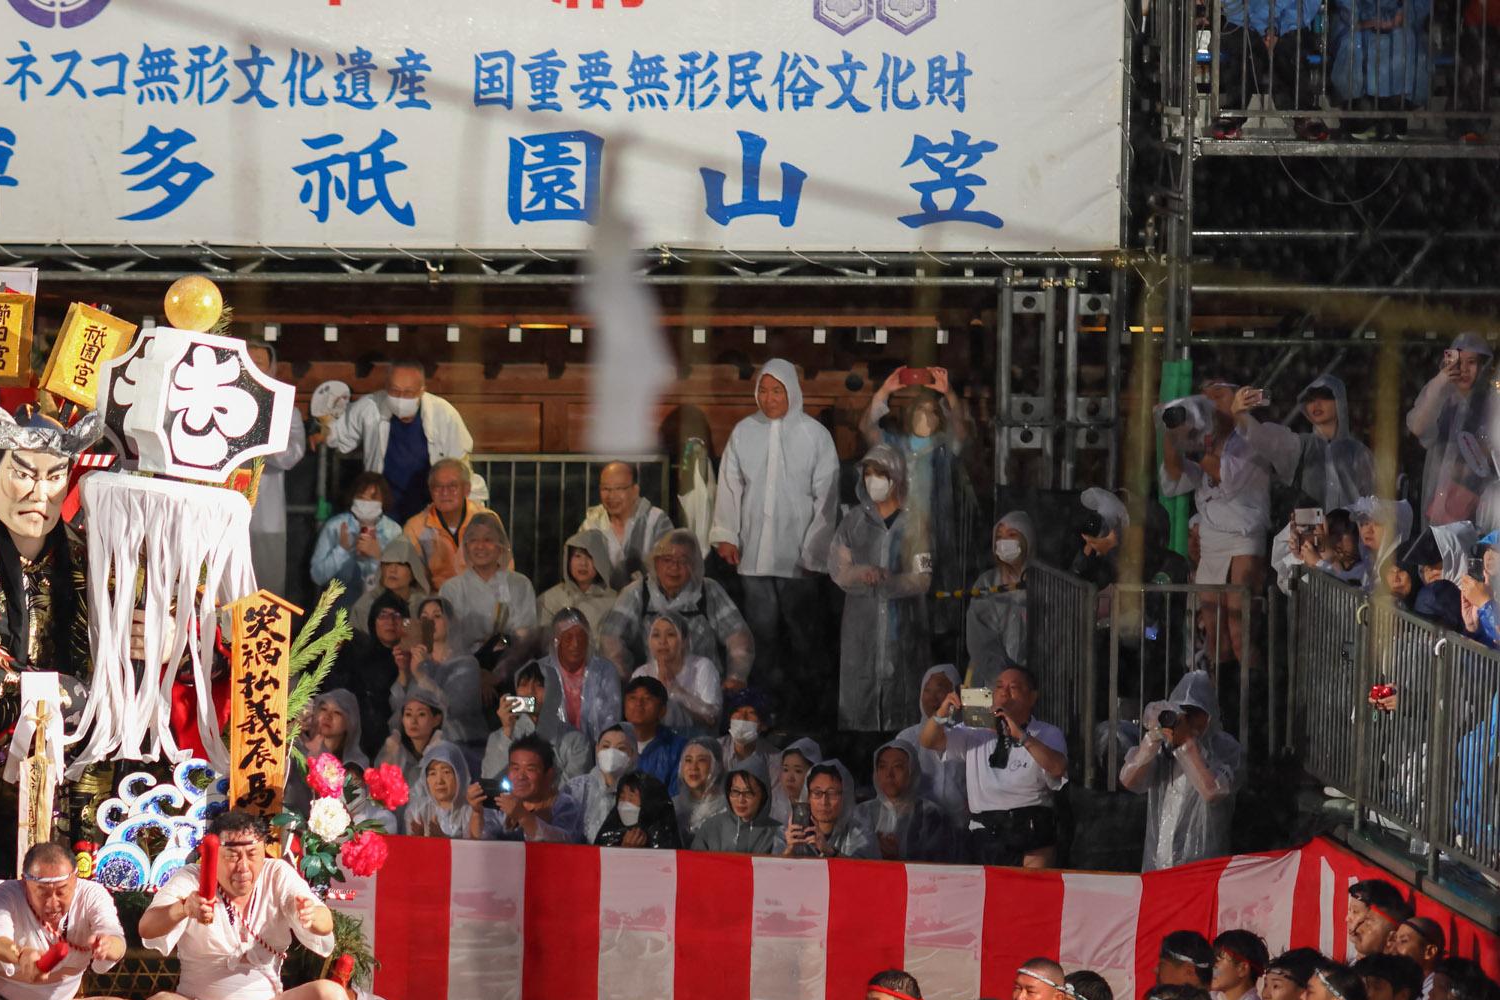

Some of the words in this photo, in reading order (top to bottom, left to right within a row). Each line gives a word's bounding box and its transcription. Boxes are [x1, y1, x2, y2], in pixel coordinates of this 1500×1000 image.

[473, 49, 973, 113] 国重要無形民俗文化財
[73, 325, 107, 387] 祇園宮
